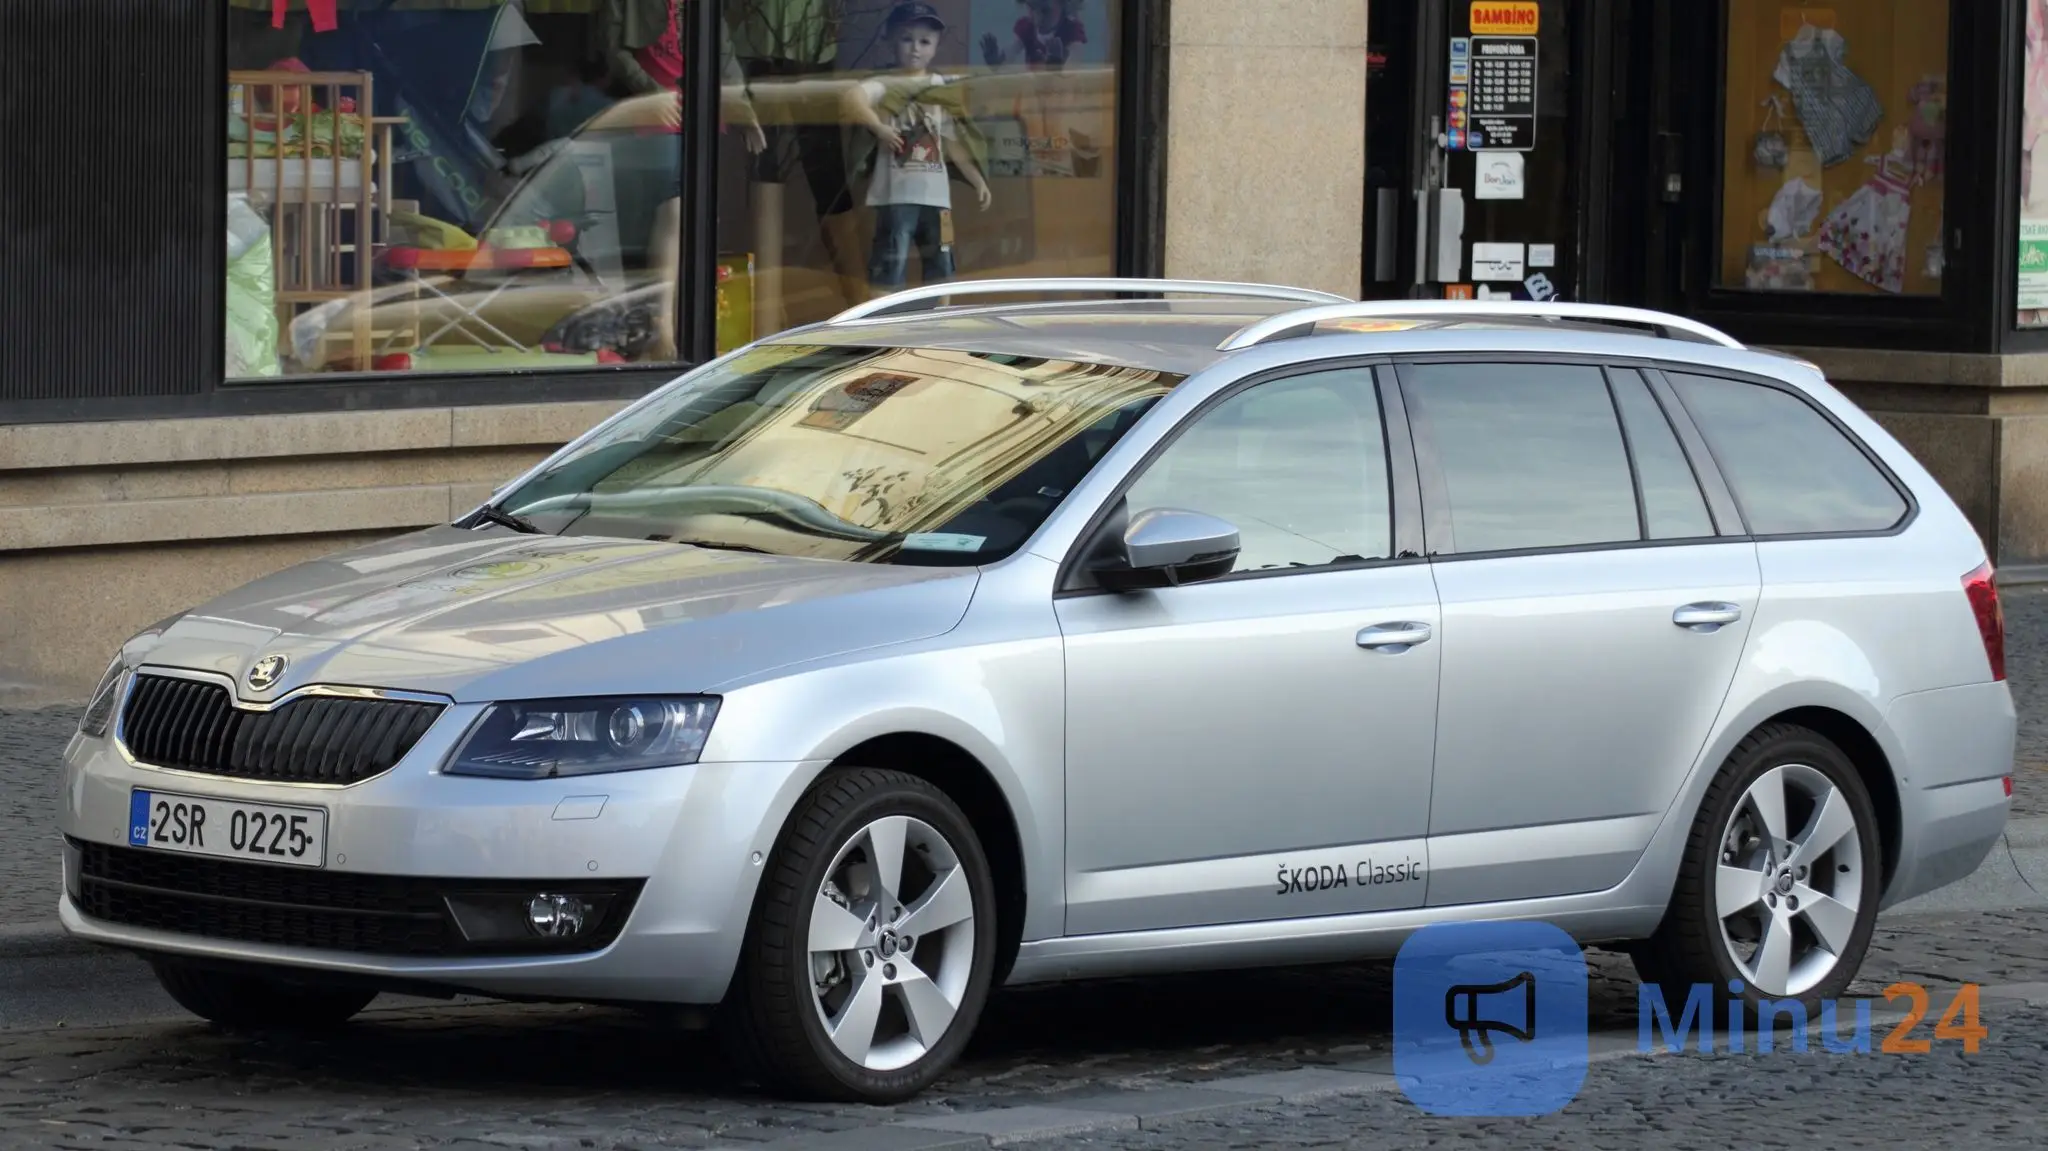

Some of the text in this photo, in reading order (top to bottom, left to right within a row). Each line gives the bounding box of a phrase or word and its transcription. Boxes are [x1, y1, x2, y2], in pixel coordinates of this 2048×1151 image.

[133, 826, 147, 840] CZ
[154, 800, 308, 857] 2SR 0225
[1277, 856, 1421, 896] ŠKODA Classic
